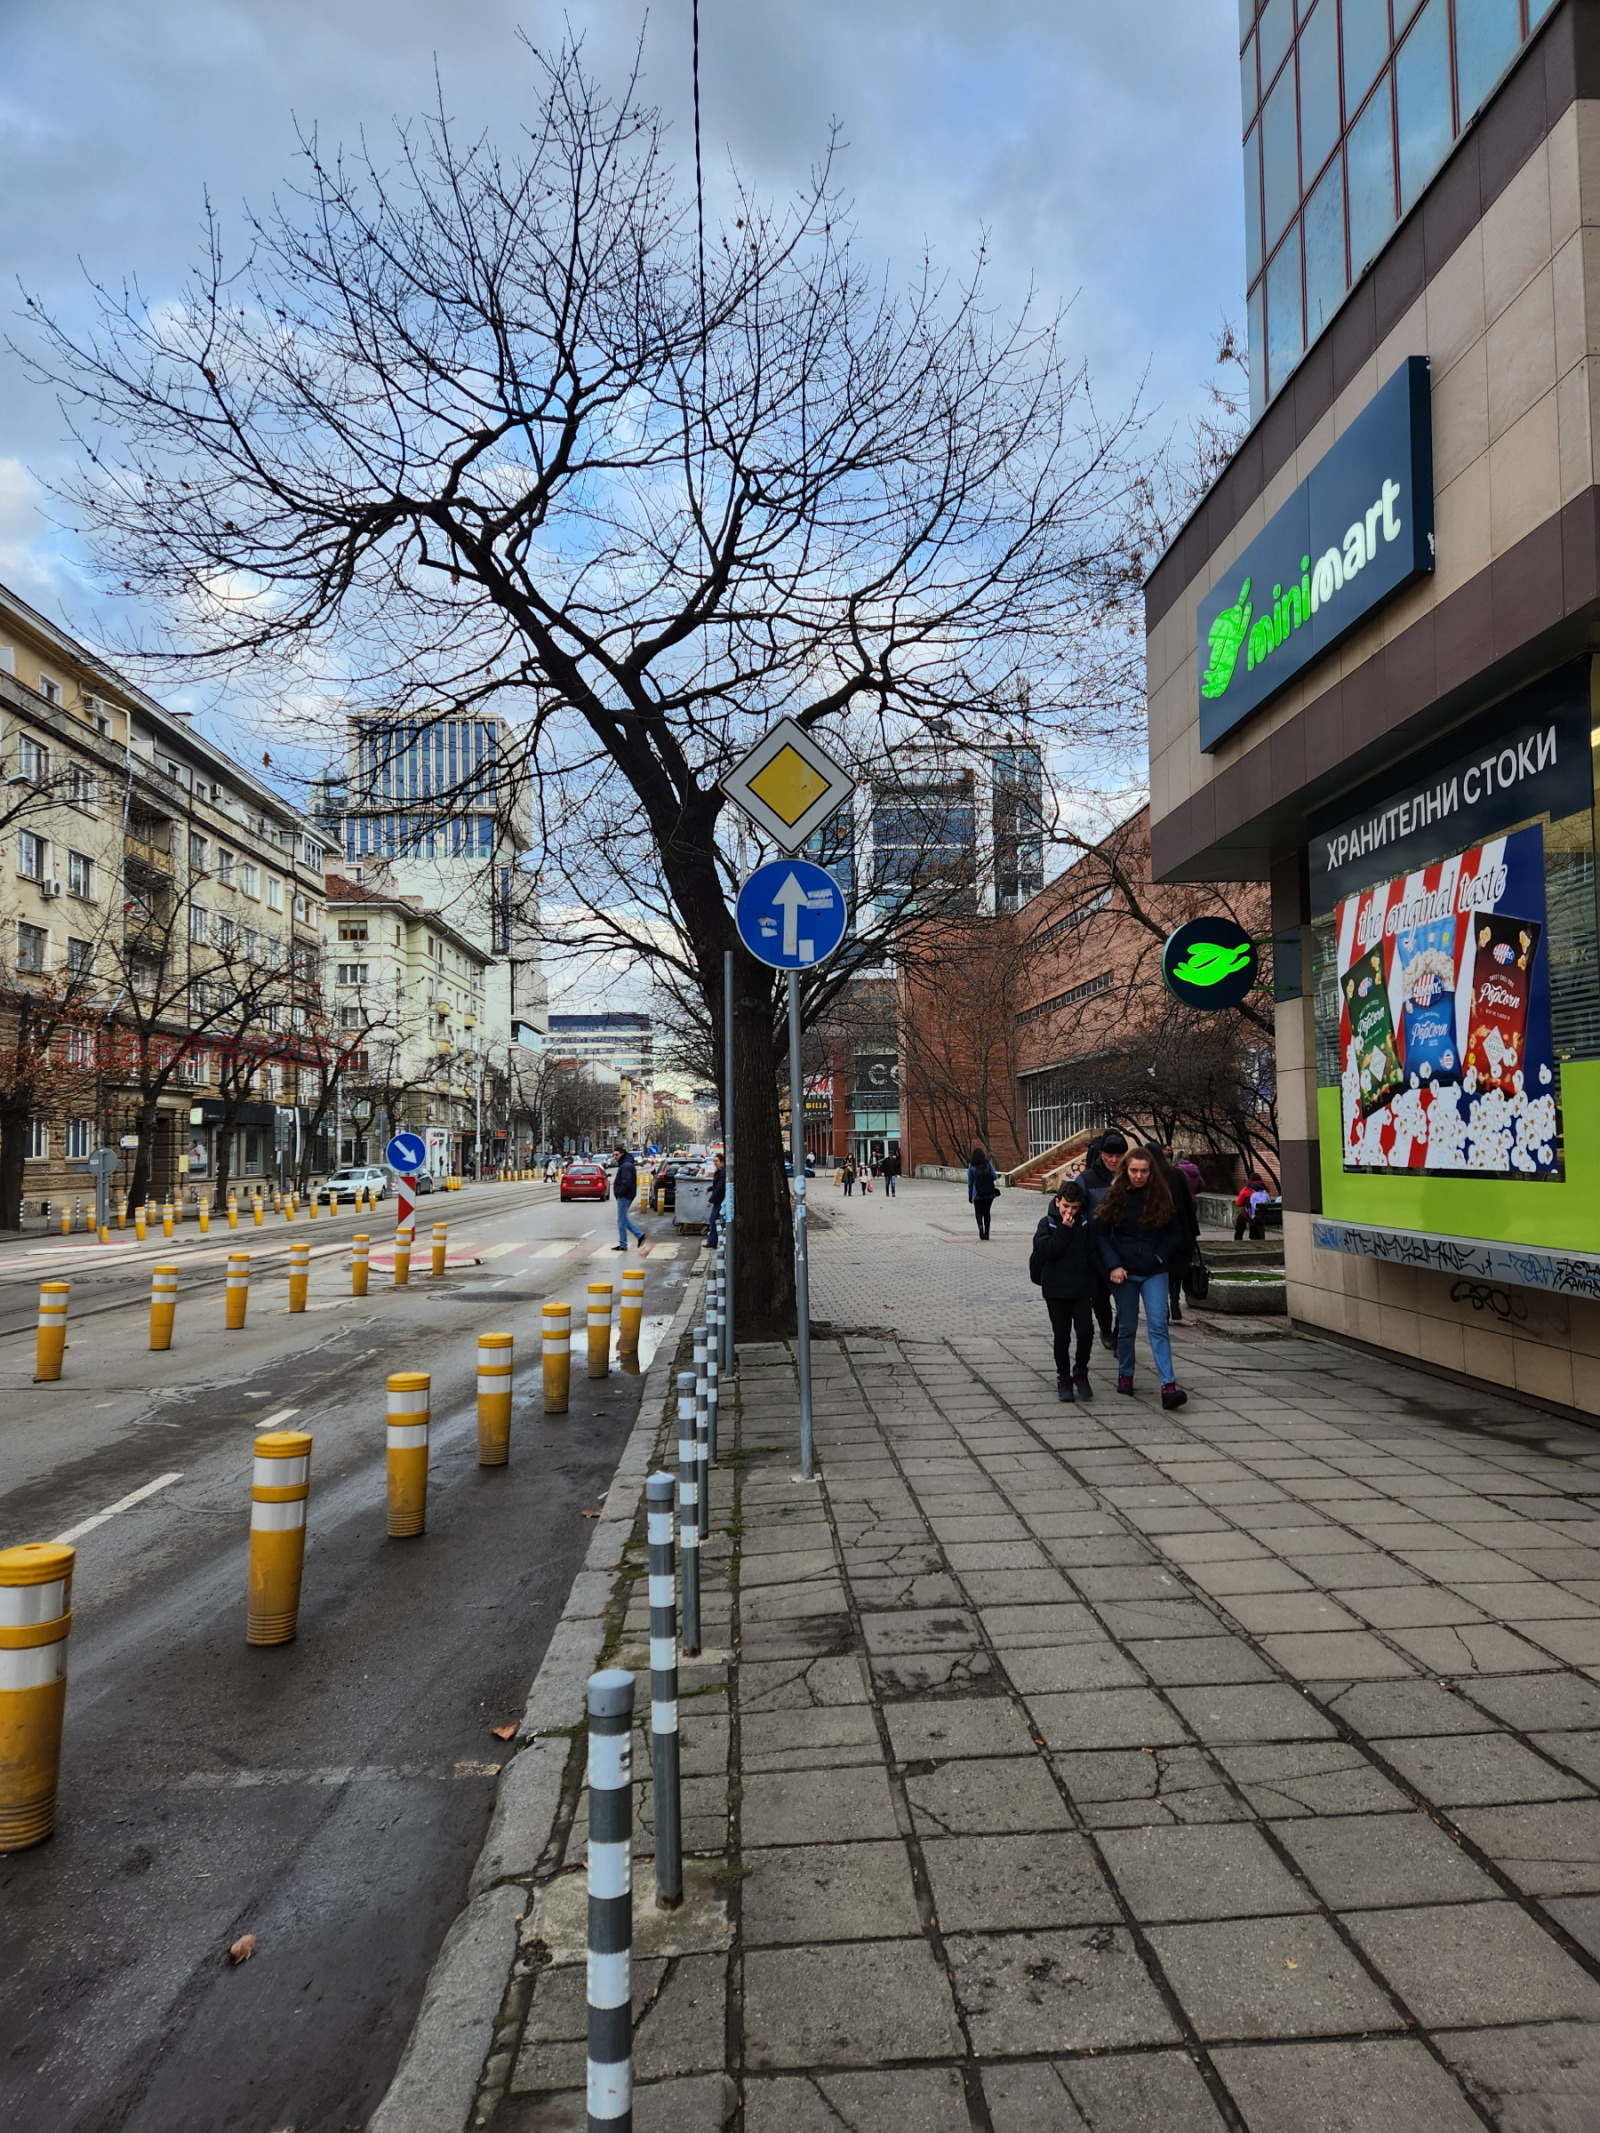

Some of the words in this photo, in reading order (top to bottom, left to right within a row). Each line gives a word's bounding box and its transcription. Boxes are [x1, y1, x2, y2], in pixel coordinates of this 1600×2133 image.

[1247, 478, 1401, 671] minimart
[1327, 776, 1459, 872] ХРАНИТЕЛНИ
[1463, 725, 1558, 805] СТОКИ
[1357, 898, 1382, 945] the
[1385, 871, 1455, 946] original
[1459, 864, 1508, 912] taste
